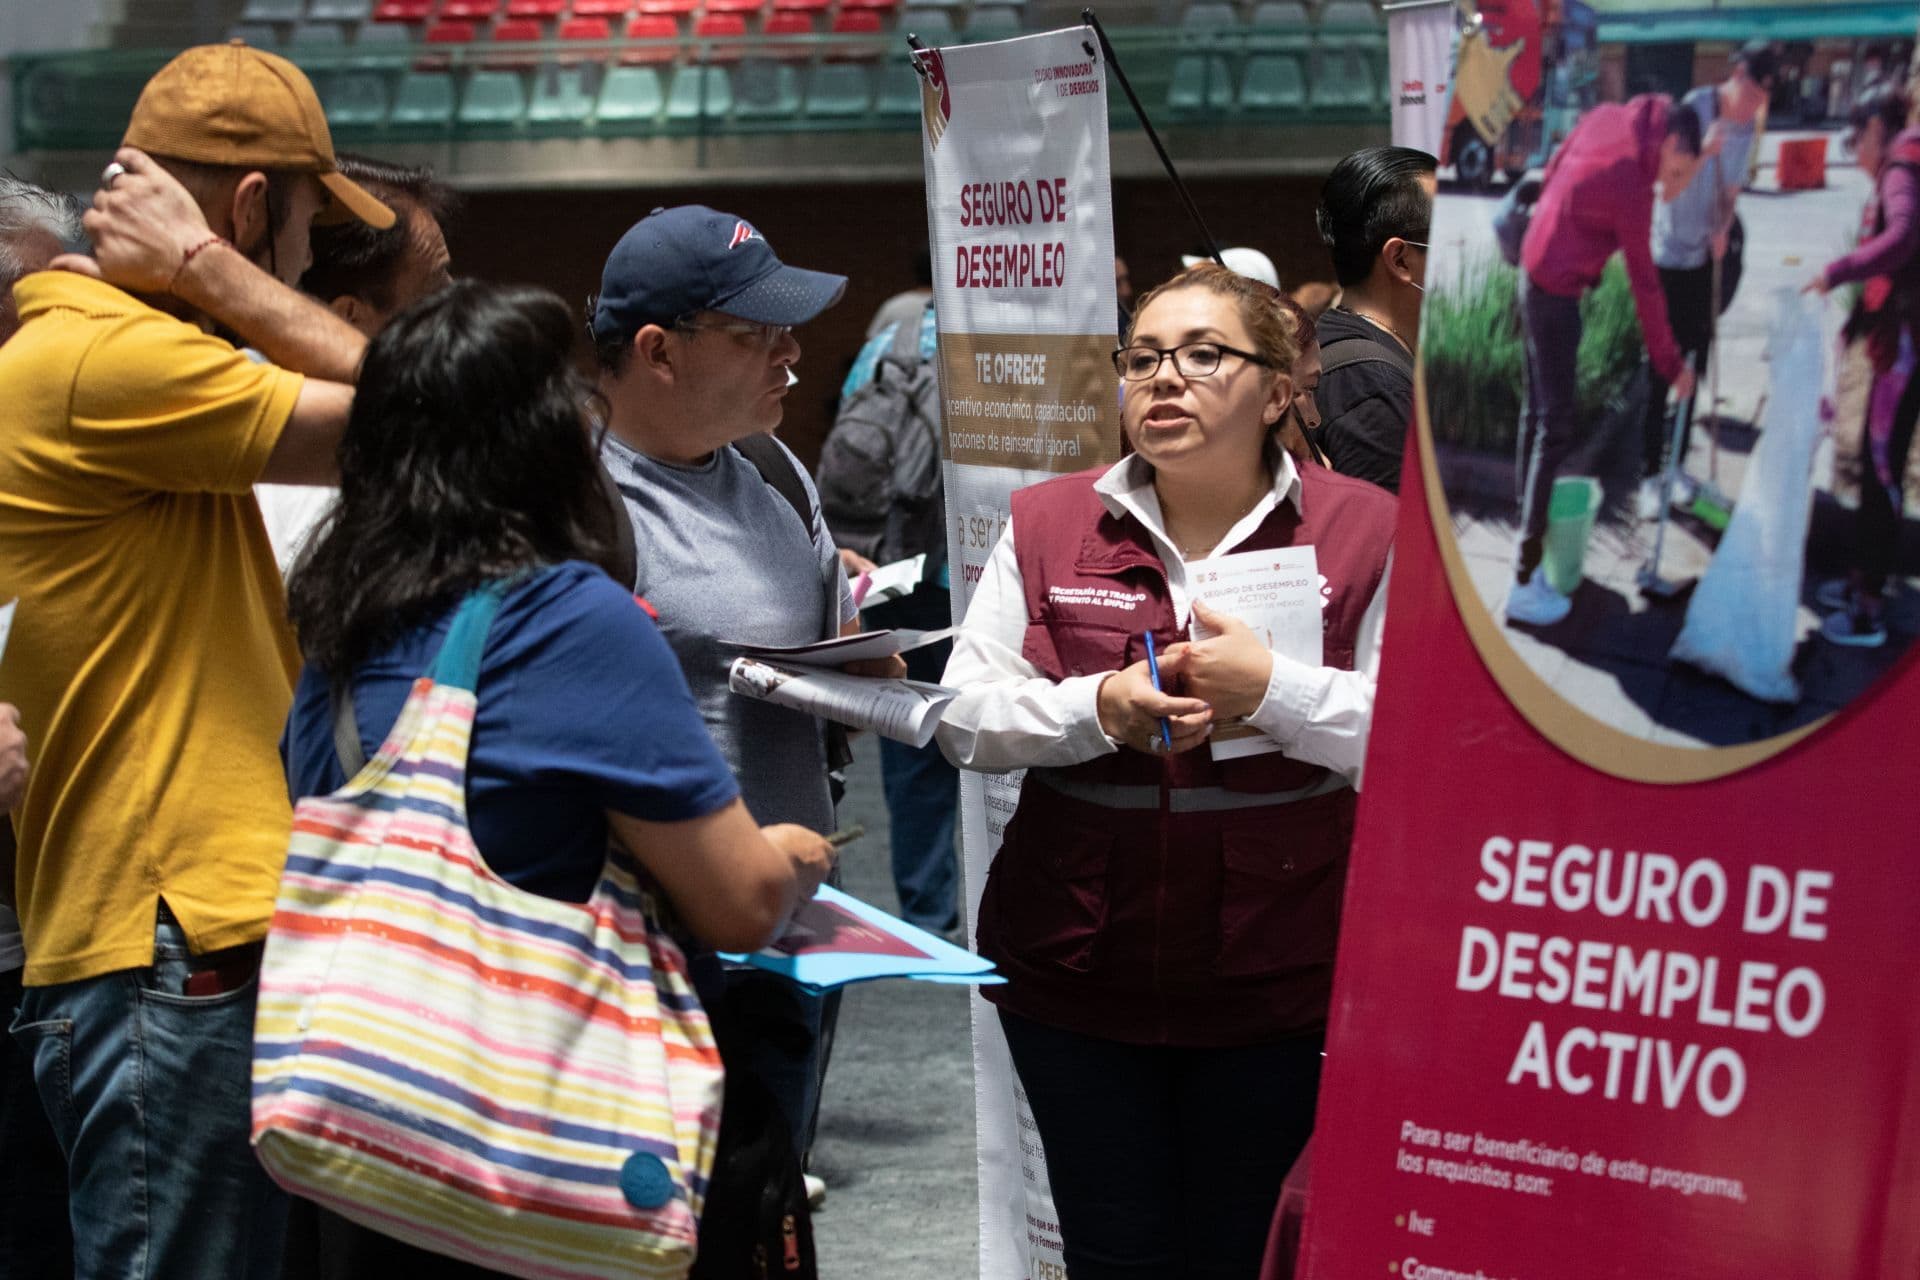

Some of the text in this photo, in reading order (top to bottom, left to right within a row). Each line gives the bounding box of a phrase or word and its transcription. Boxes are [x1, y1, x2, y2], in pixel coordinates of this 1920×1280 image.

[1053, 62, 1092, 79] INNOVADORA
[1069, 80, 1099, 95] DERECHOS
[960, 177, 1066, 227] SEGURO DE
[956, 241, 1065, 288] DESEMPLEO
[975, 352, 1047, 385] TE OFRECE
[985, 397, 1033, 423] económico,
[987, 430, 999, 451] de
[969, 517, 993, 549] ser
[1048, 595, 1136, 610] Y FOMENTO AL EMPLEO
[1050, 586, 1147, 602] SECRETARÍA DE TRABAJO
[1203, 579, 1309, 599] SEGURO DE DESEMPLEO
[1238, 592, 1278, 603] ACTIVO
[1475, 836, 1833, 941] SEGURO DE
[1456, 926, 1826, 1038] DESEMPLEO
[1507, 1020, 1746, 1117] ACTIVO
[1401, 1121, 1441, 1148] Para
[1444, 1131, 1472, 1153] ser
[1474, 1132, 1579, 1171] beneficiario
[1581, 1151, 1607, 1176] de
[1608, 1157, 1649, 1183] este
[1397, 1149, 1553, 1196] los requisitos son:
